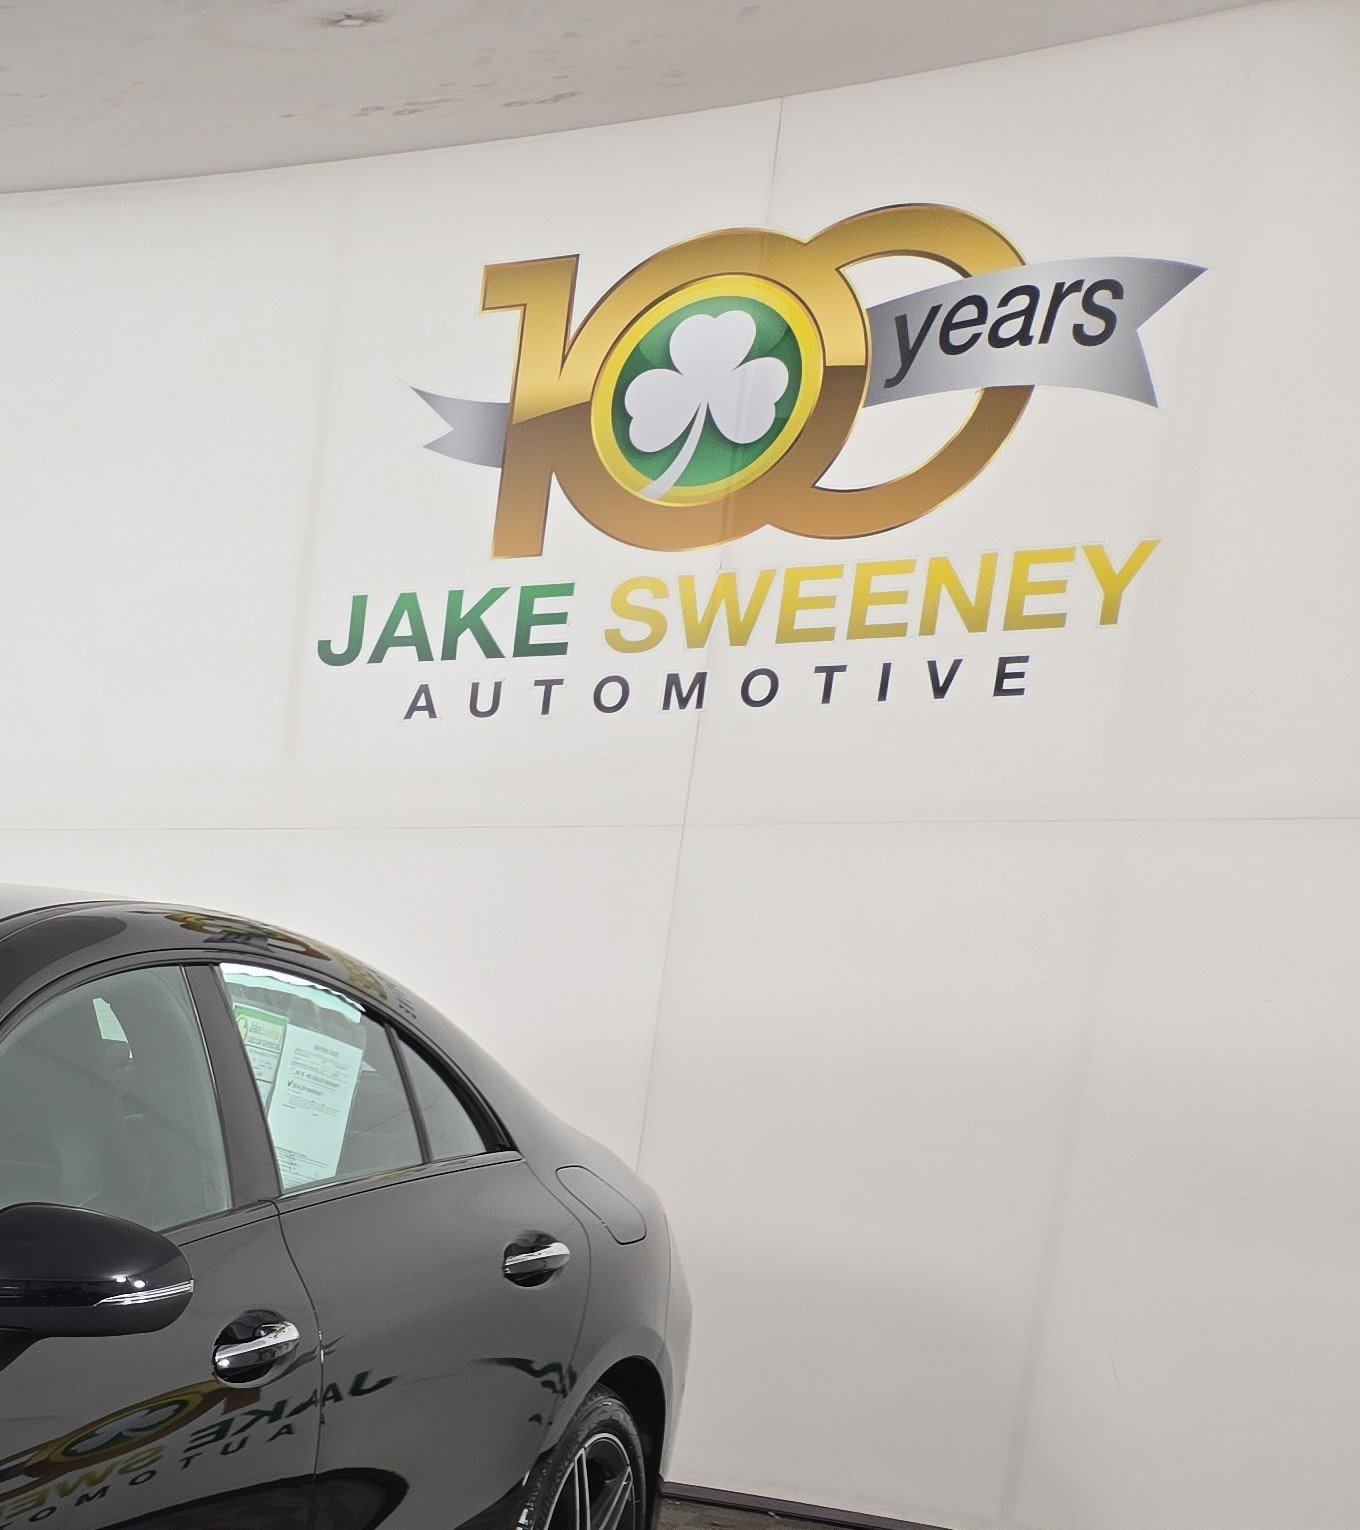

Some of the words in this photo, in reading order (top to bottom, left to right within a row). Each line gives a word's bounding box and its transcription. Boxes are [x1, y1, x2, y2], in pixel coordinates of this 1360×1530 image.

[884, 277, 1125, 389] years
[316, 581, 576, 668] JAKE
[603, 538, 1160, 654] SWEENEY
[403, 654, 1032, 720] AUTOMOTIVE
